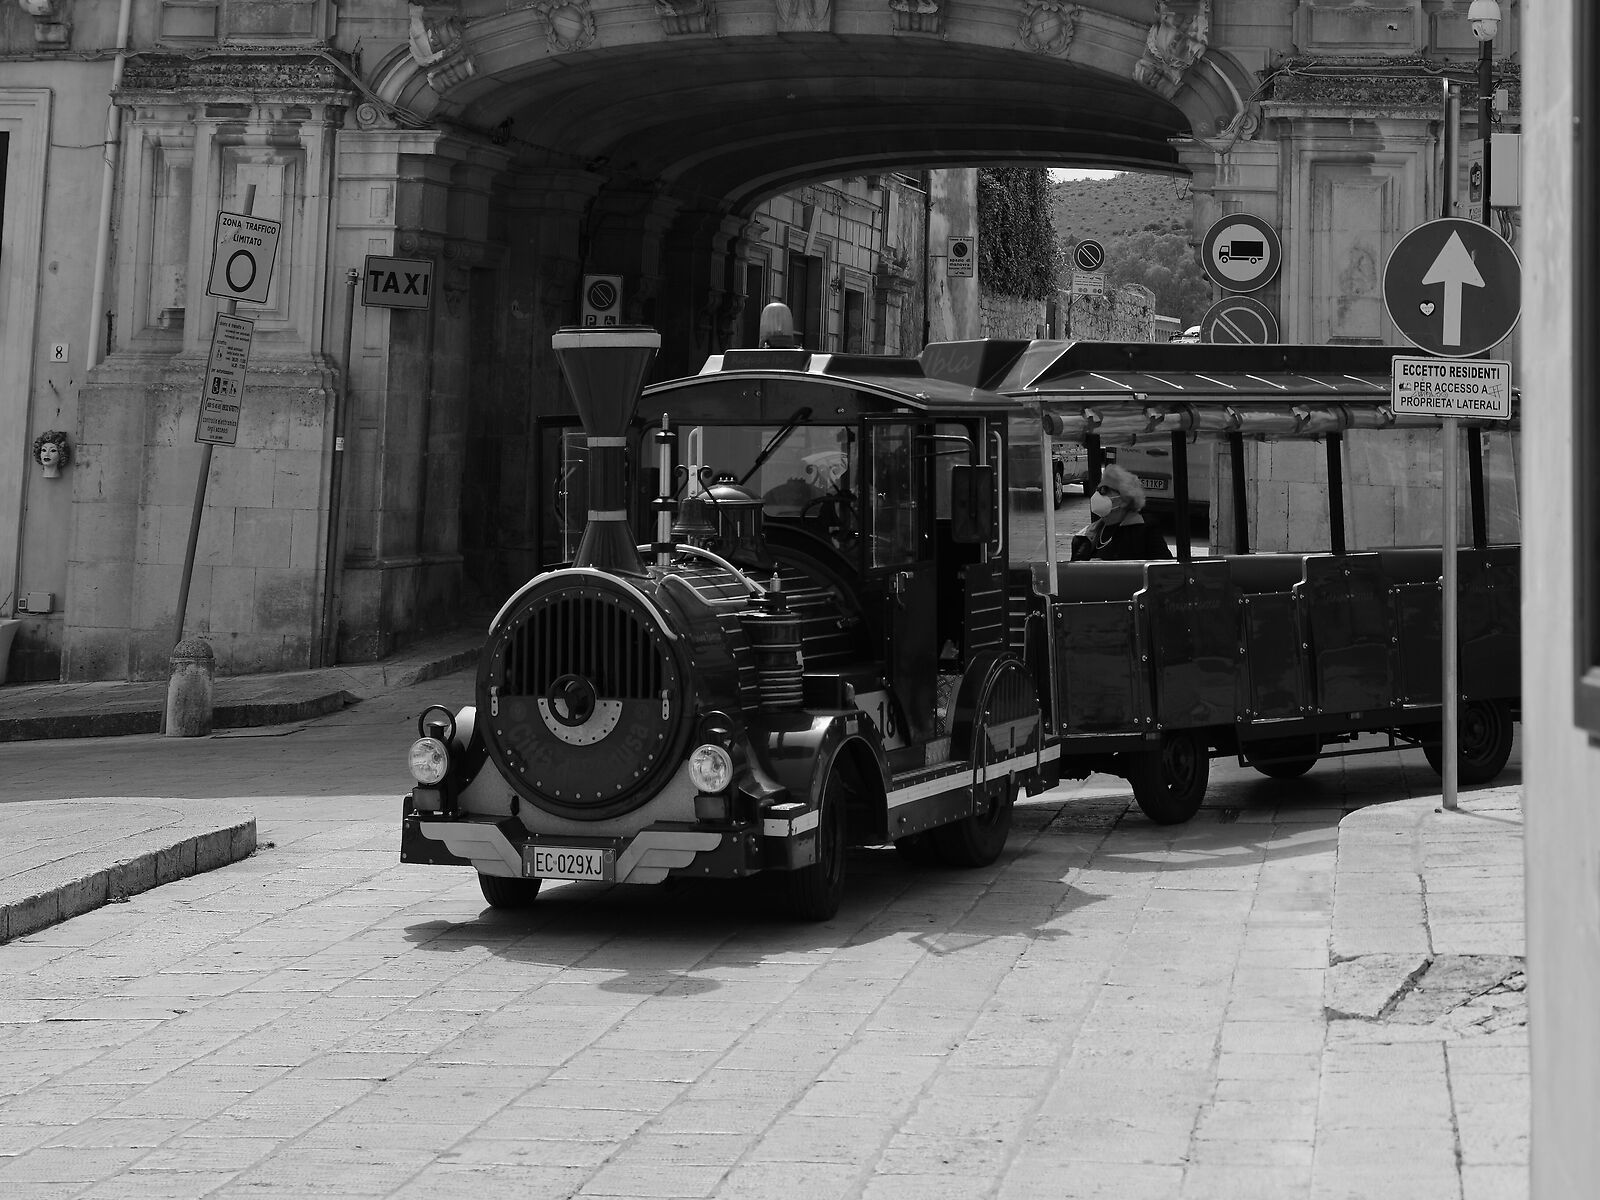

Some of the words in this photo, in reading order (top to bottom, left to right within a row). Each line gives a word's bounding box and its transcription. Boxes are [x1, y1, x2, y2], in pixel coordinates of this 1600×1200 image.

[222, 217, 242, 228] ZONA
[245, 221, 277, 235] TRAFFICO
[233, 233, 262, 246] LIMITATO
[369, 270, 429, 296] TAXI
[55, 345, 63, 360] 8
[1402, 364, 1447, 377] ECCETTO
[1449, 366, 1500, 380] RESIDENTI
[1413, 381, 1432, 392] PER
[1434, 382, 1479, 394] ACCESSO
[1481, 384, 1488, 394] A
[1400, 396, 1455, 408] PROPRIETA'
[1456, 399, 1501, 411] LATERALI
